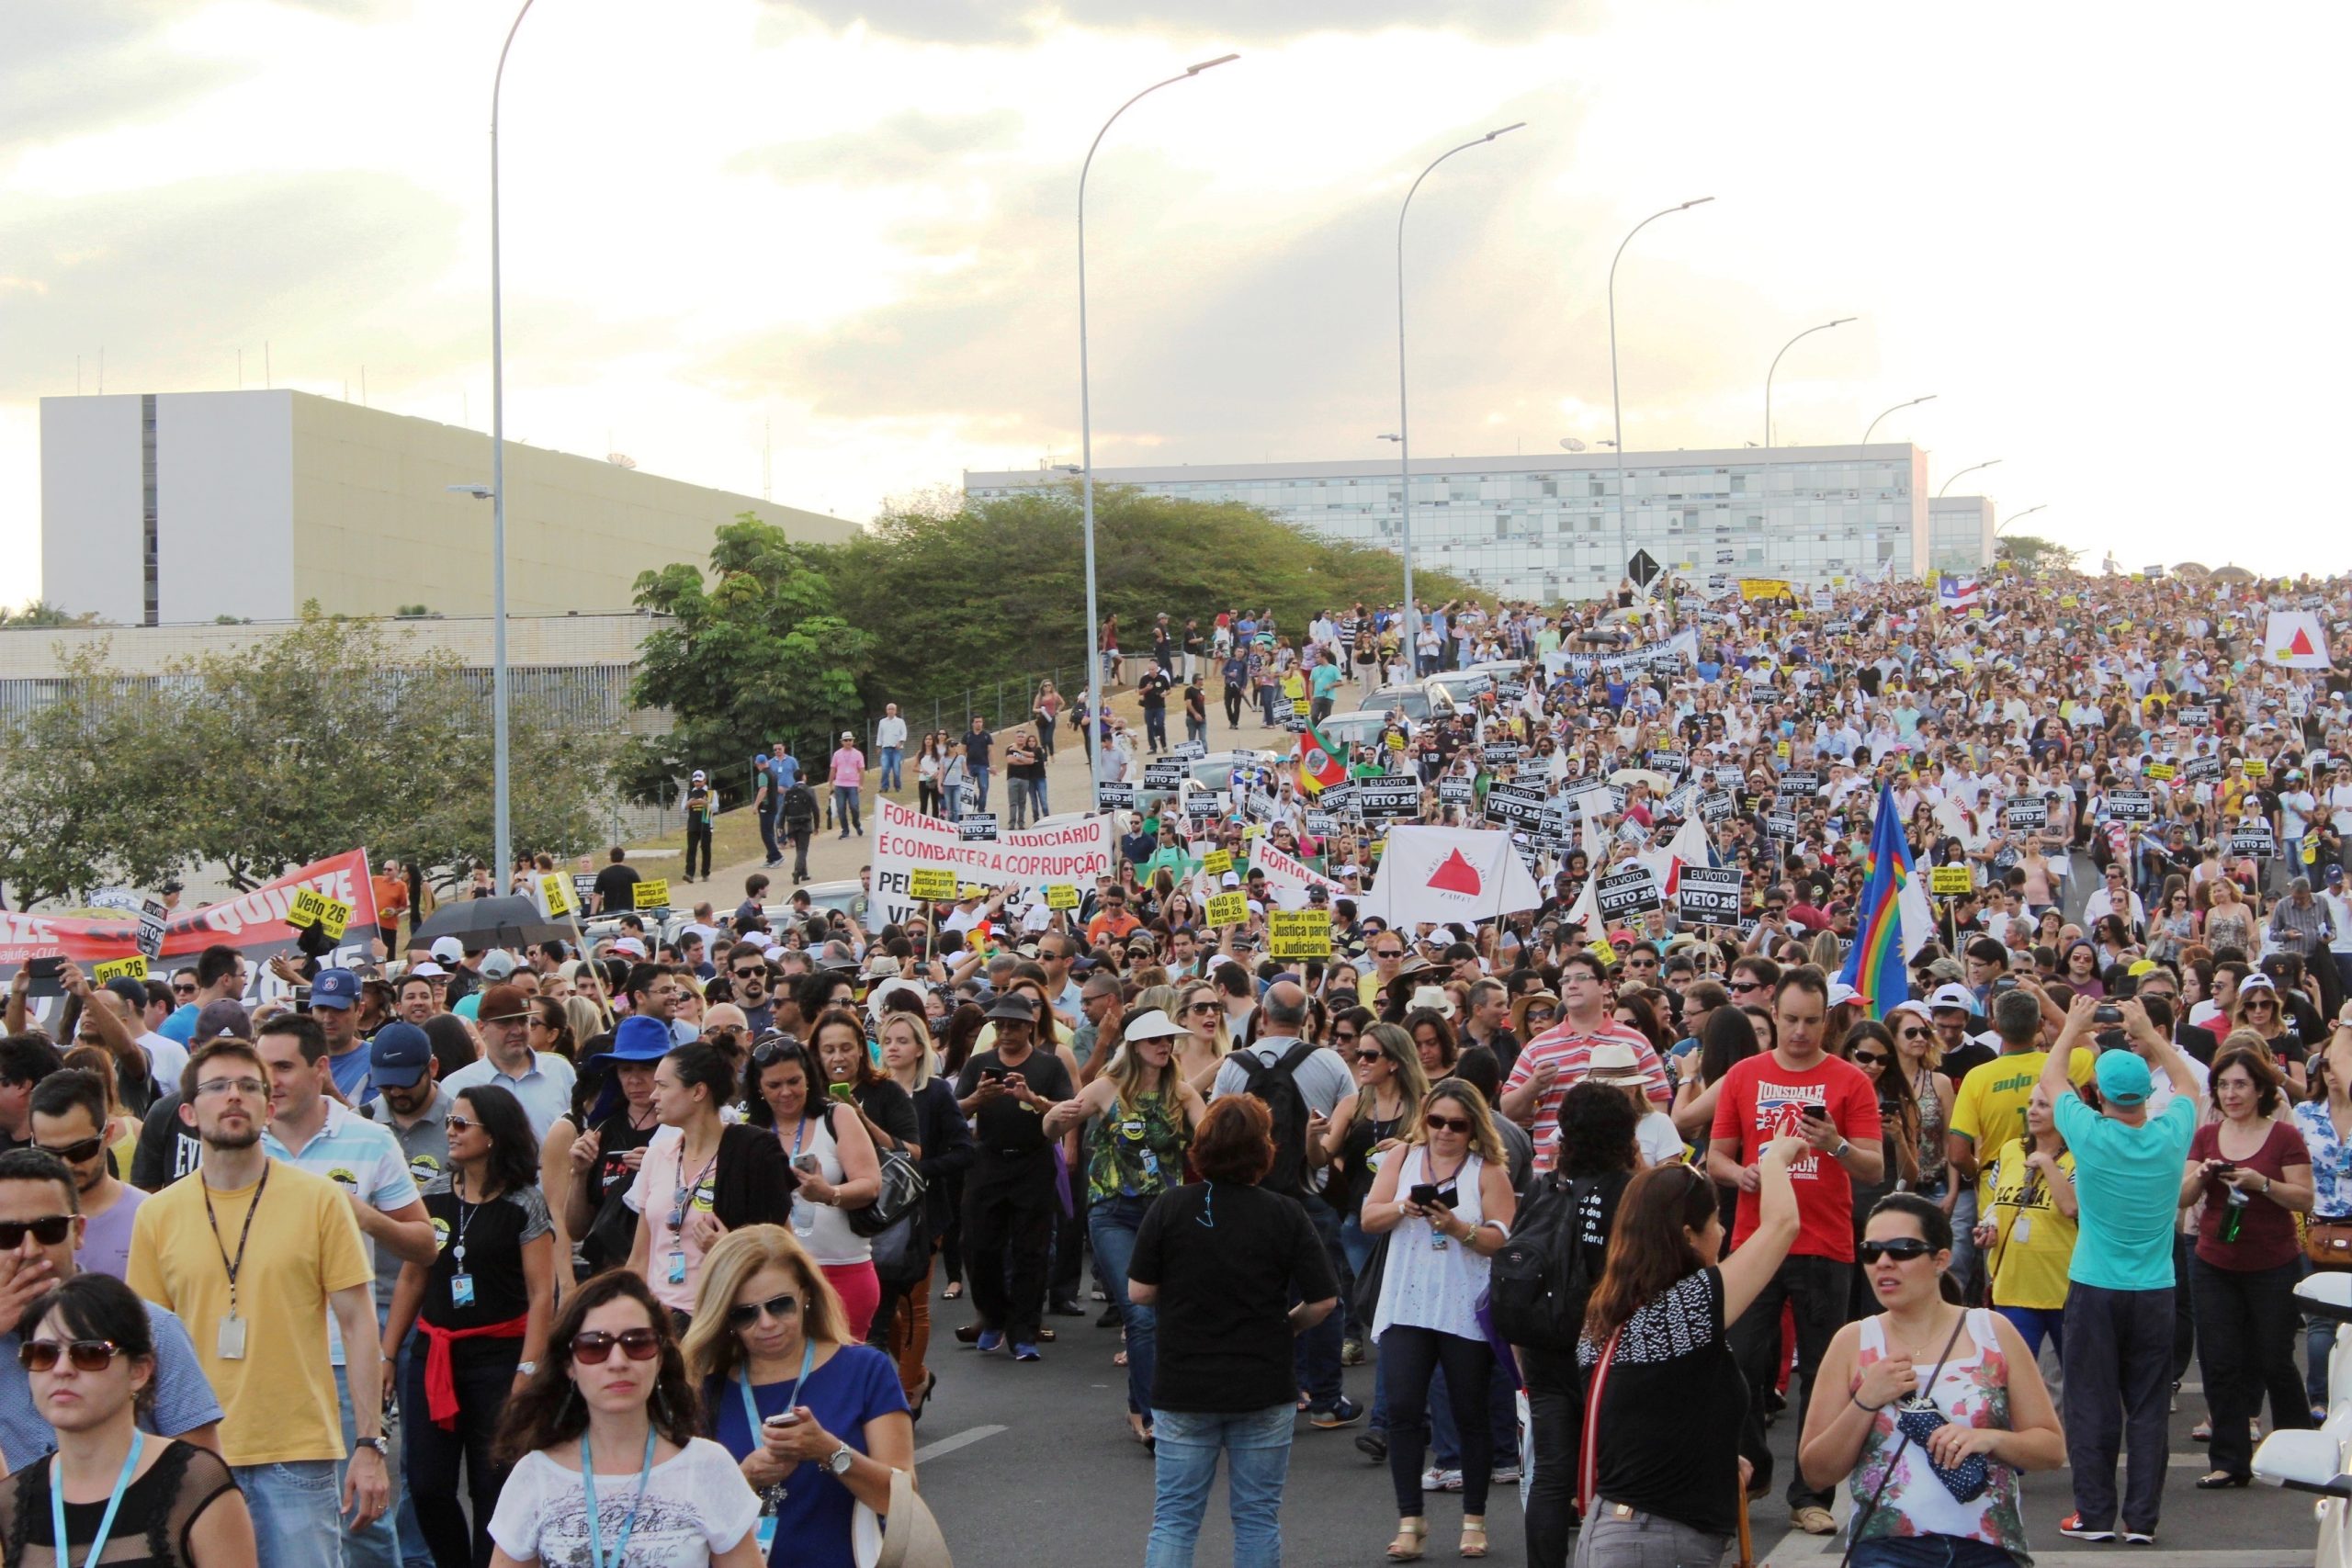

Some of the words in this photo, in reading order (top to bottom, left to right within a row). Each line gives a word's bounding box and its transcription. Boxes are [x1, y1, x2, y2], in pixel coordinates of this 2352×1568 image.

[1333, 783, 1350, 791] VOTO
[1384, 778, 1408, 786] VOTO
[1499, 785, 1511, 794] EU
[1512, 788, 1536, 799] VOTO
[1323, 795, 1345, 807] VETO
[1363, 795, 1397, 806] VETO
[1400, 794, 1416, 805] 26
[1488, 799, 1523, 816] VETO
[1524, 809, 1542, 820] 26
[2110, 803, 2135, 812] VETO
[2009, 813, 2033, 821] VETO
[884, 803, 960, 834] FORAL
[1006, 823, 1100, 846] JUDICIÁRIO
[879, 830, 889, 853] É
[892, 837, 987, 868] COMBATER
[990, 854, 1001, 871] A
[1261, 845, 1342, 894] FORTAL
[1691, 870, 1702, 879] EU
[1703, 871, 1729, 881] VOTO
[878, 872, 910, 895] PEL
[1605, 879, 1617, 887] EU
[1620, 873, 1644, 885] VOTO
[297, 891, 325, 916] Veto
[548, 891, 564, 909] PLC
[1601, 891, 1637, 908] VETO
[1640, 886, 1656, 900] 26
[1682, 891, 1718, 907] VETO
[1721, 896, 1737, 908] 26
[145, 902, 153, 911] EU
[1211, 907, 1228, 919] Veto
[1231, 905, 1242, 915] 26
[138, 919, 156, 939] VETO
[1273, 924, 1306, 940] Justiça
[1309, 927, 1329, 938] para
[1274, 943, 1279, 954] o
[96, 965, 122, 984] Veto
[1756, 1080, 1826, 1105] LONSDALE
[1590, 1195, 1601, 1204] de
[1586, 1220, 1596, 1230] do
[1582, 1233, 1603, 1245] deral
